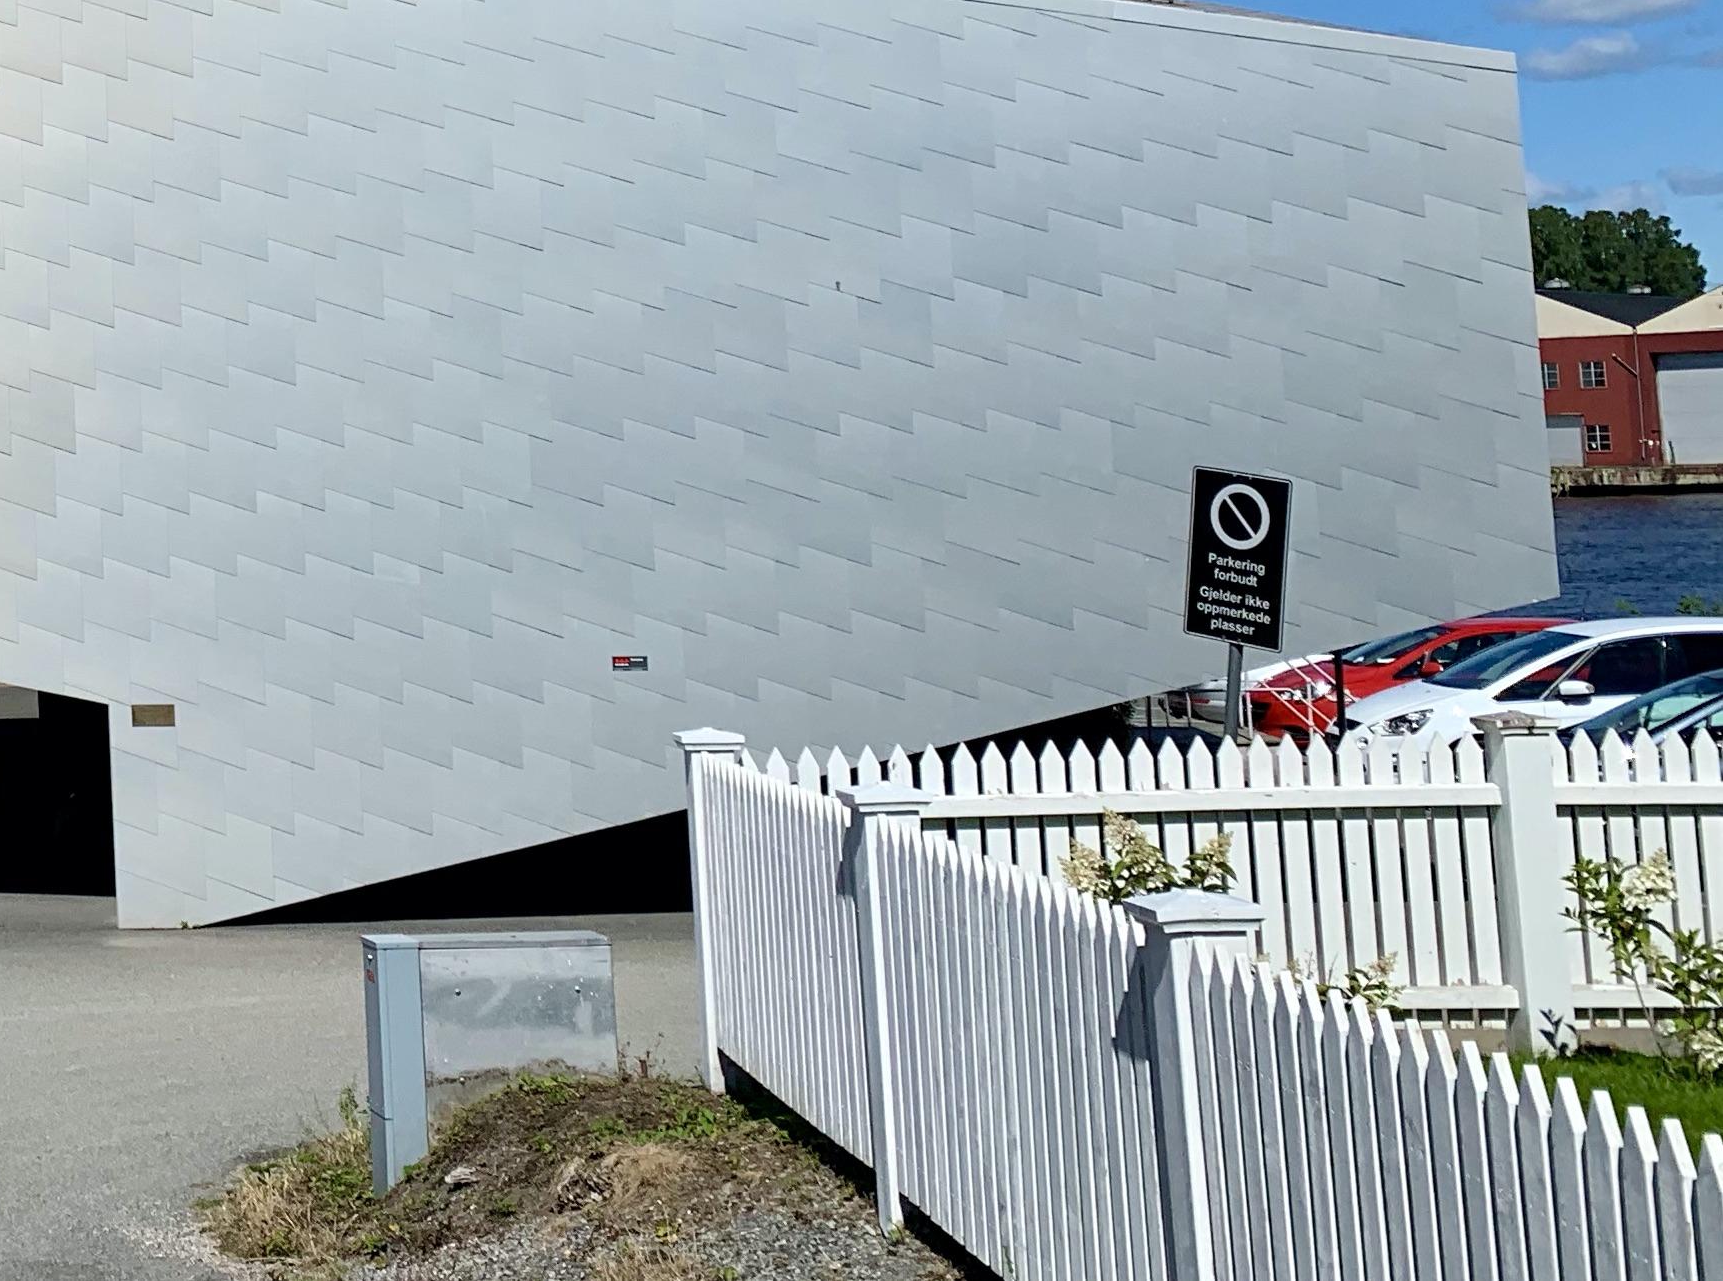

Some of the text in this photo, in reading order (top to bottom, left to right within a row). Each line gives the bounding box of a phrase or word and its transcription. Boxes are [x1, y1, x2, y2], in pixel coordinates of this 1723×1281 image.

[1208, 552, 1266, 576] Parkering
[1214, 568, 1258, 587] forbudt
[1199, 586, 1270, 609] Gjelder ikke
[1196, 602, 1271, 624] oppmerkede
[1210, 617, 1255, 635] plasser
